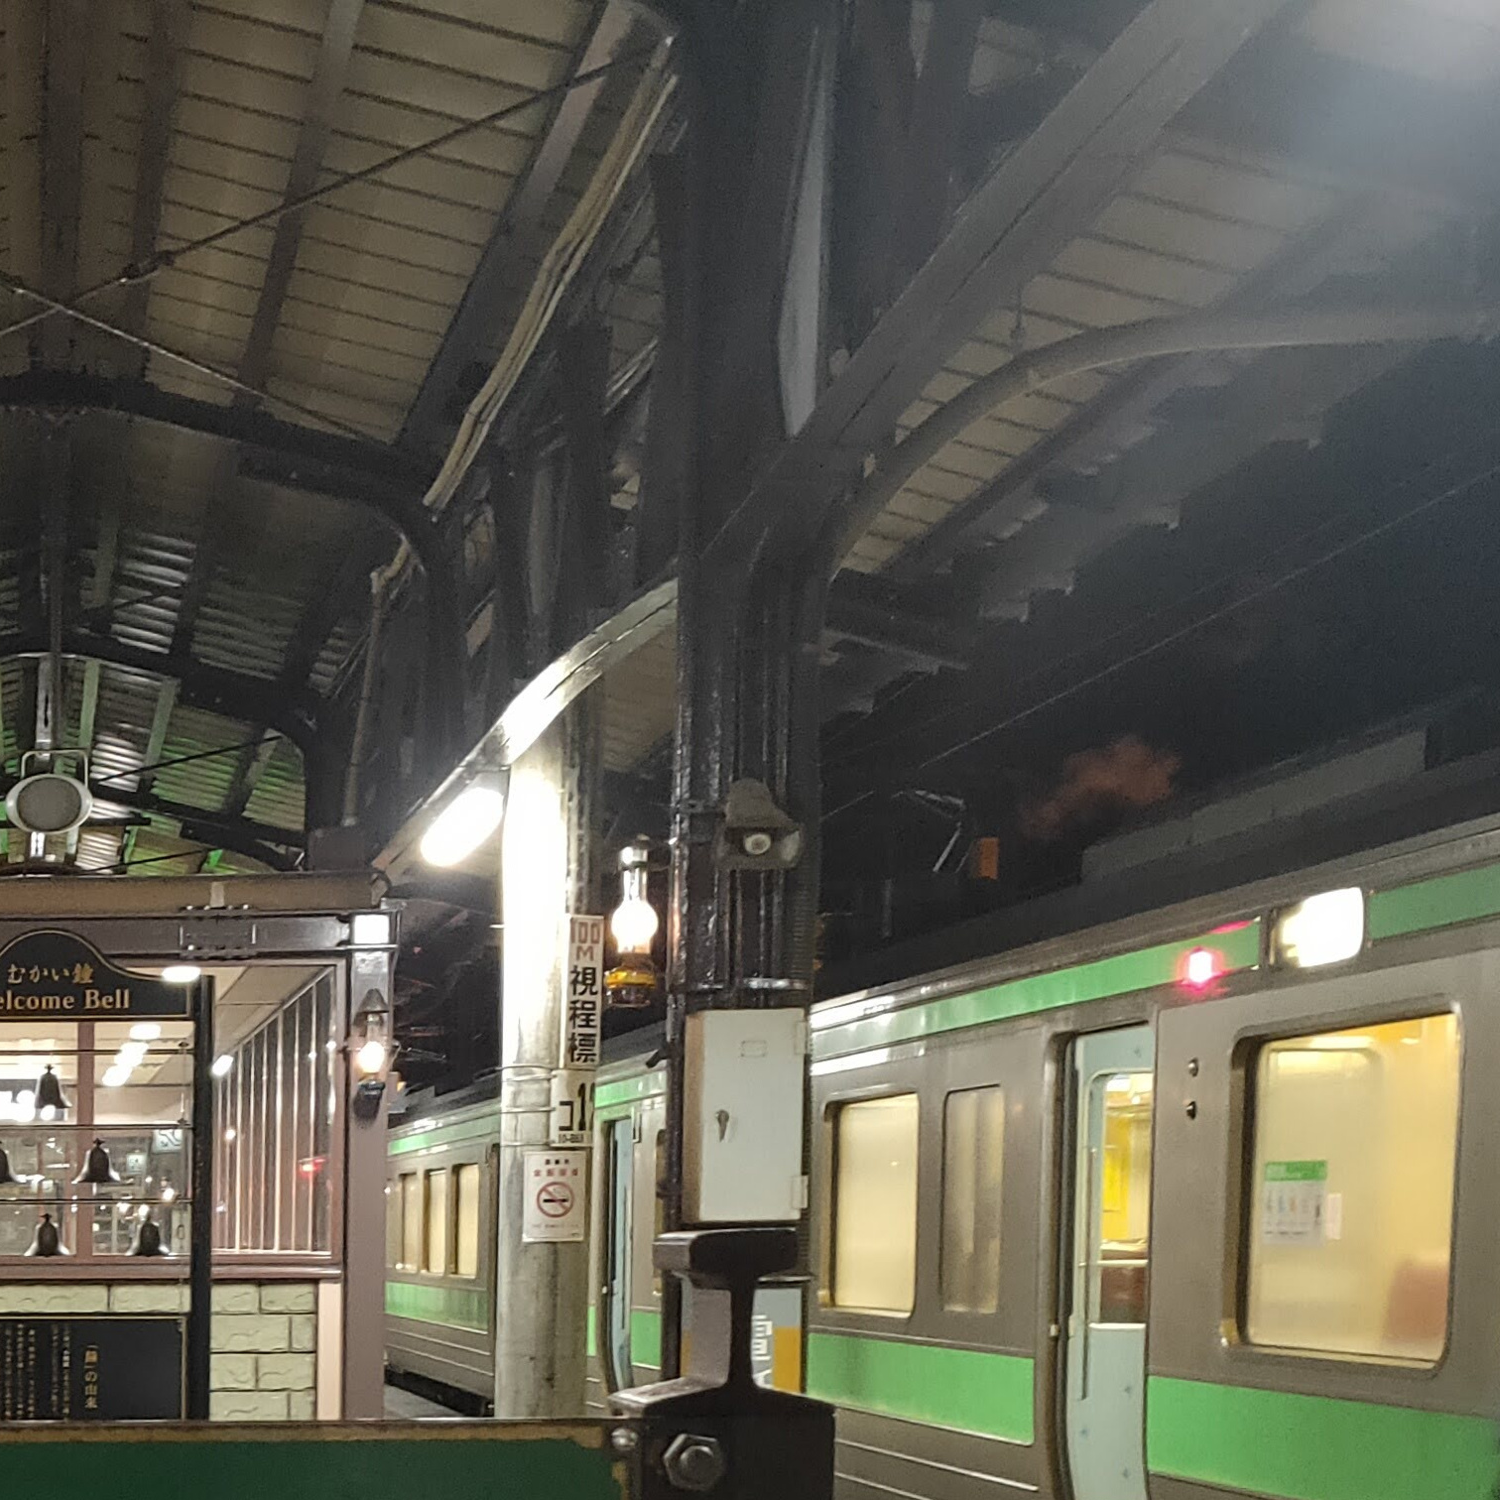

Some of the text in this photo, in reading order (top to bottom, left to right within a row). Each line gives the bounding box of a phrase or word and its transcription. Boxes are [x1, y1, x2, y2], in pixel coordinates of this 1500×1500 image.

[576, 946, 594, 961] M
[7, 963, 94, 984] むかい鐘
[85, 988, 130, 1009] Bell
[568, 965, 598, 1063] 視程標
